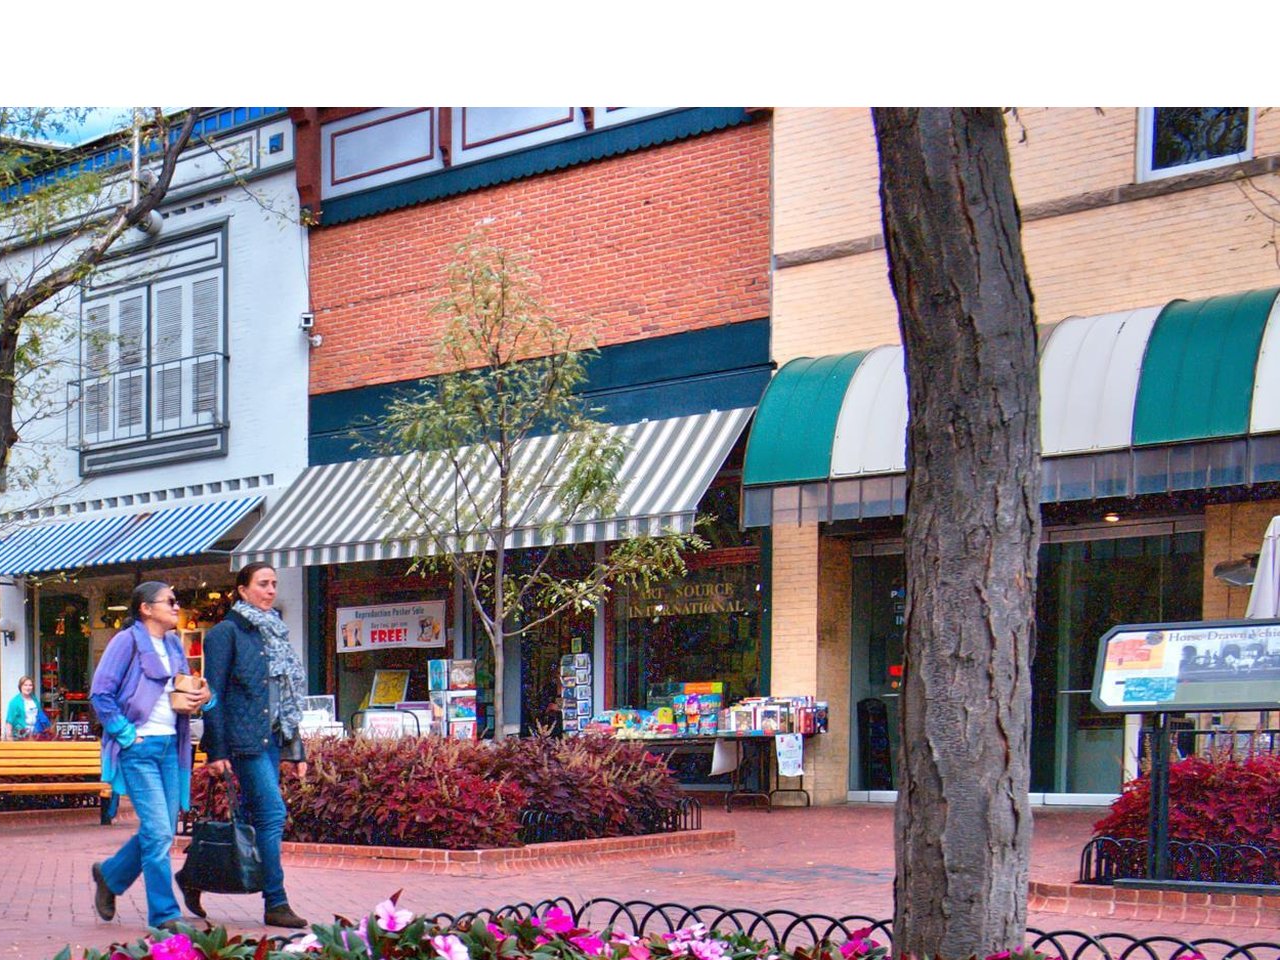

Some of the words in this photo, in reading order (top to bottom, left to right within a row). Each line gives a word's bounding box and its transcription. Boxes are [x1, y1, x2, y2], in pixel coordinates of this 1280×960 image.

[676, 583, 734, 598] SOURCE
[629, 600, 744, 618] INTERNATIONAL
[371, 628, 408, 643] FREE!
[56, 724, 89, 736] PEPPER
